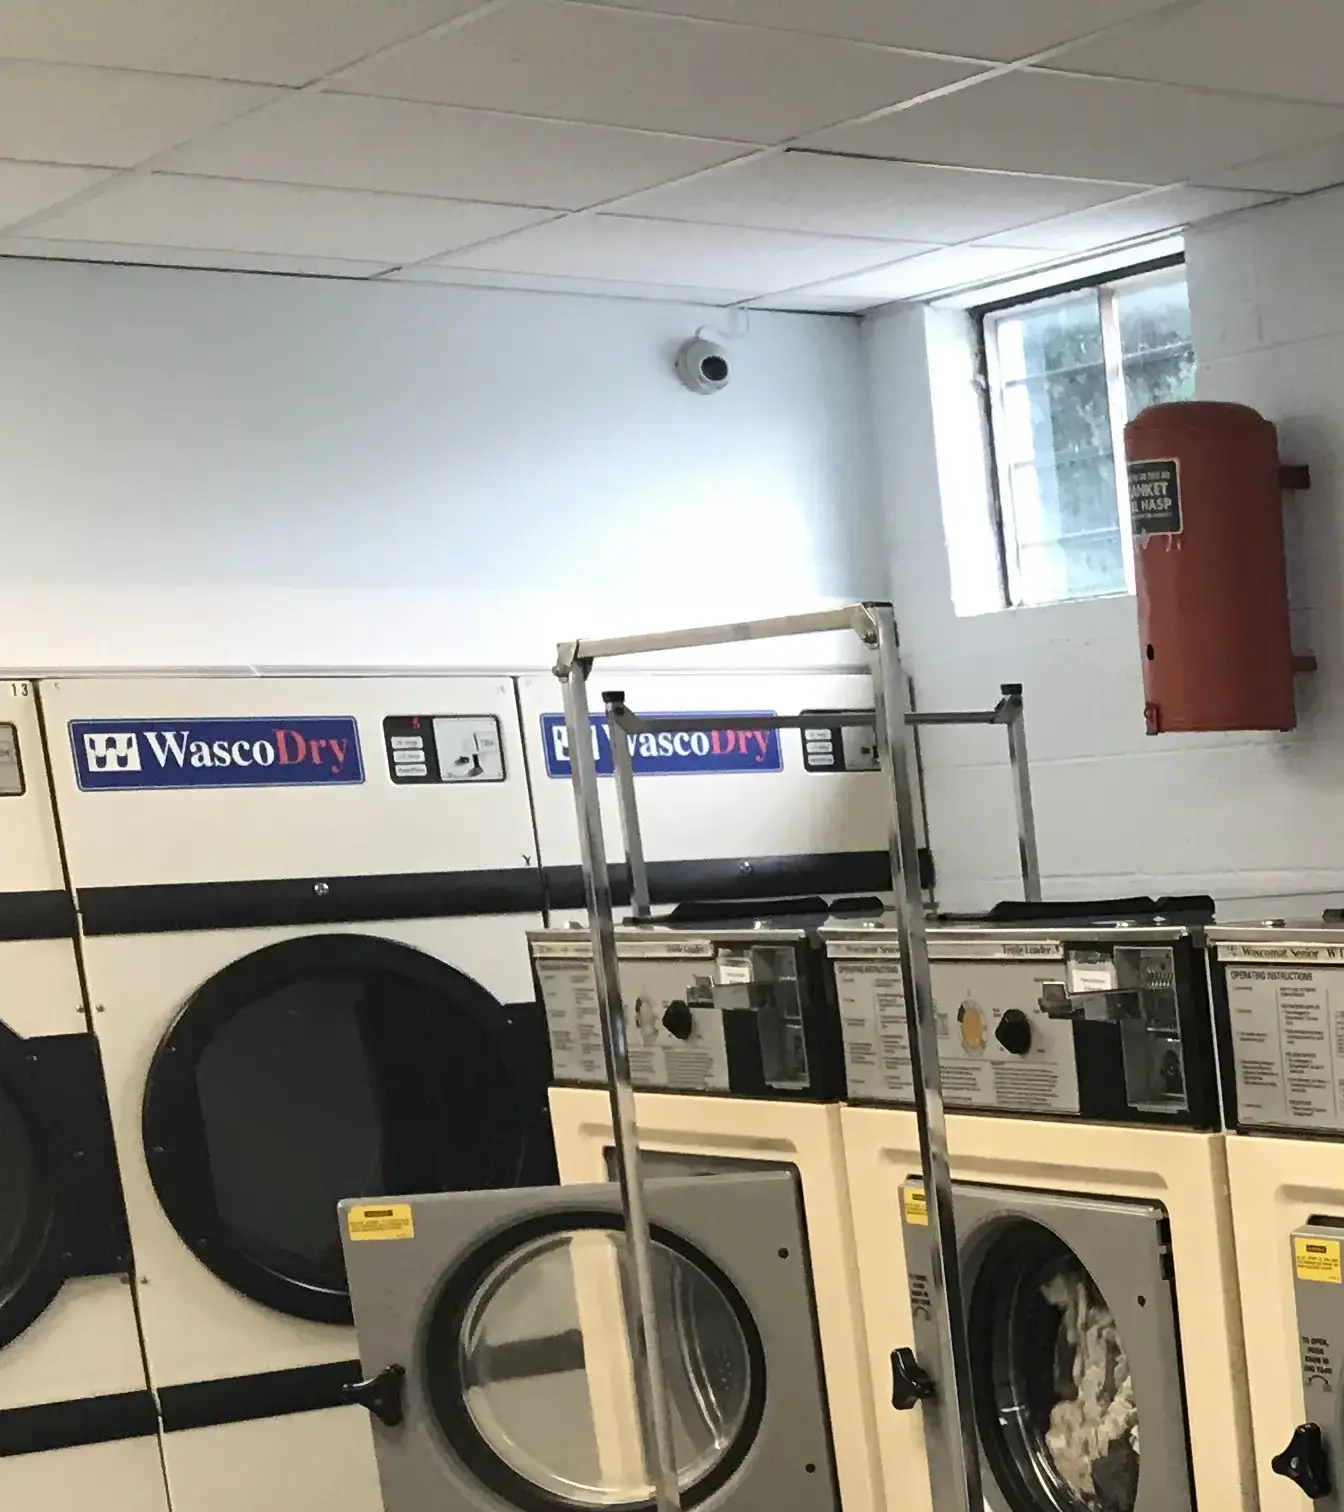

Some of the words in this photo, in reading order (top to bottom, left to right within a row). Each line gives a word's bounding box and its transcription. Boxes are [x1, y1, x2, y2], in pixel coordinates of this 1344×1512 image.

[11, 683, 29, 696] 13
[144, 728, 348, 773] WascoDry
[1229, 970, 1266, 980] OPERATING
